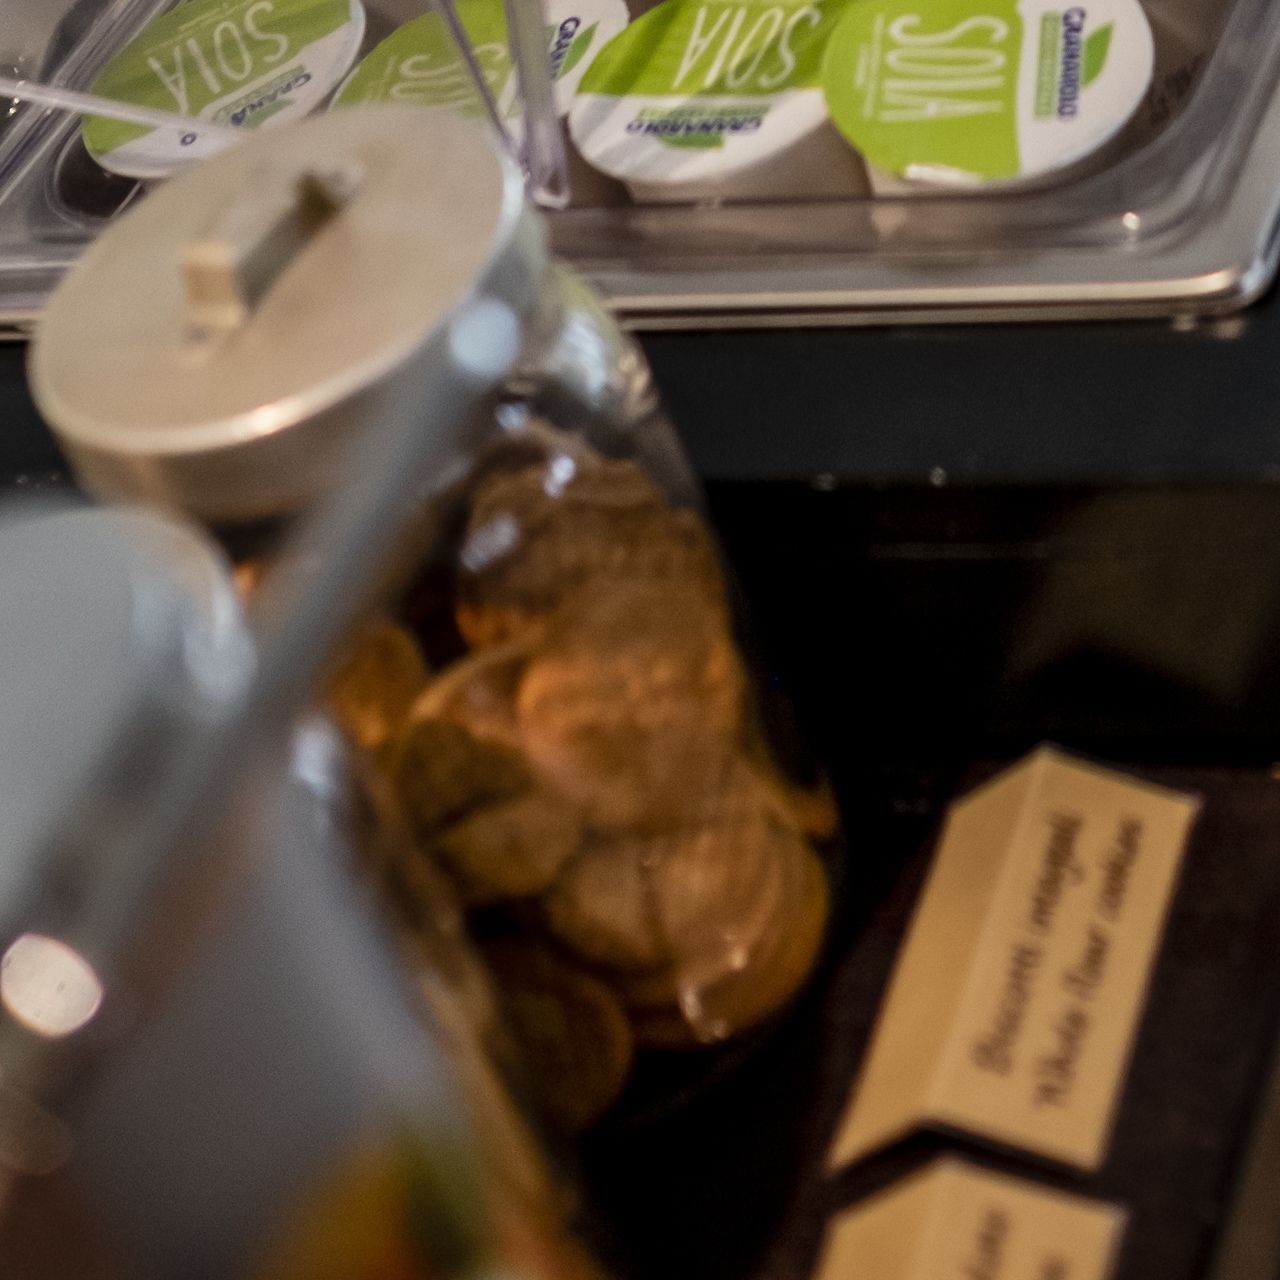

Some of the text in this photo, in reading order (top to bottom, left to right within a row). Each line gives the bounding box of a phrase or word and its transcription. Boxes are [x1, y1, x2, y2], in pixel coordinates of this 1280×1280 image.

[147, 0, 289, 117] SOIA
[672, 5, 820, 89] SOIA
[878, 15, 1008, 123] SOIA
[1057, 7, 1086, 119] GRANAROLO
